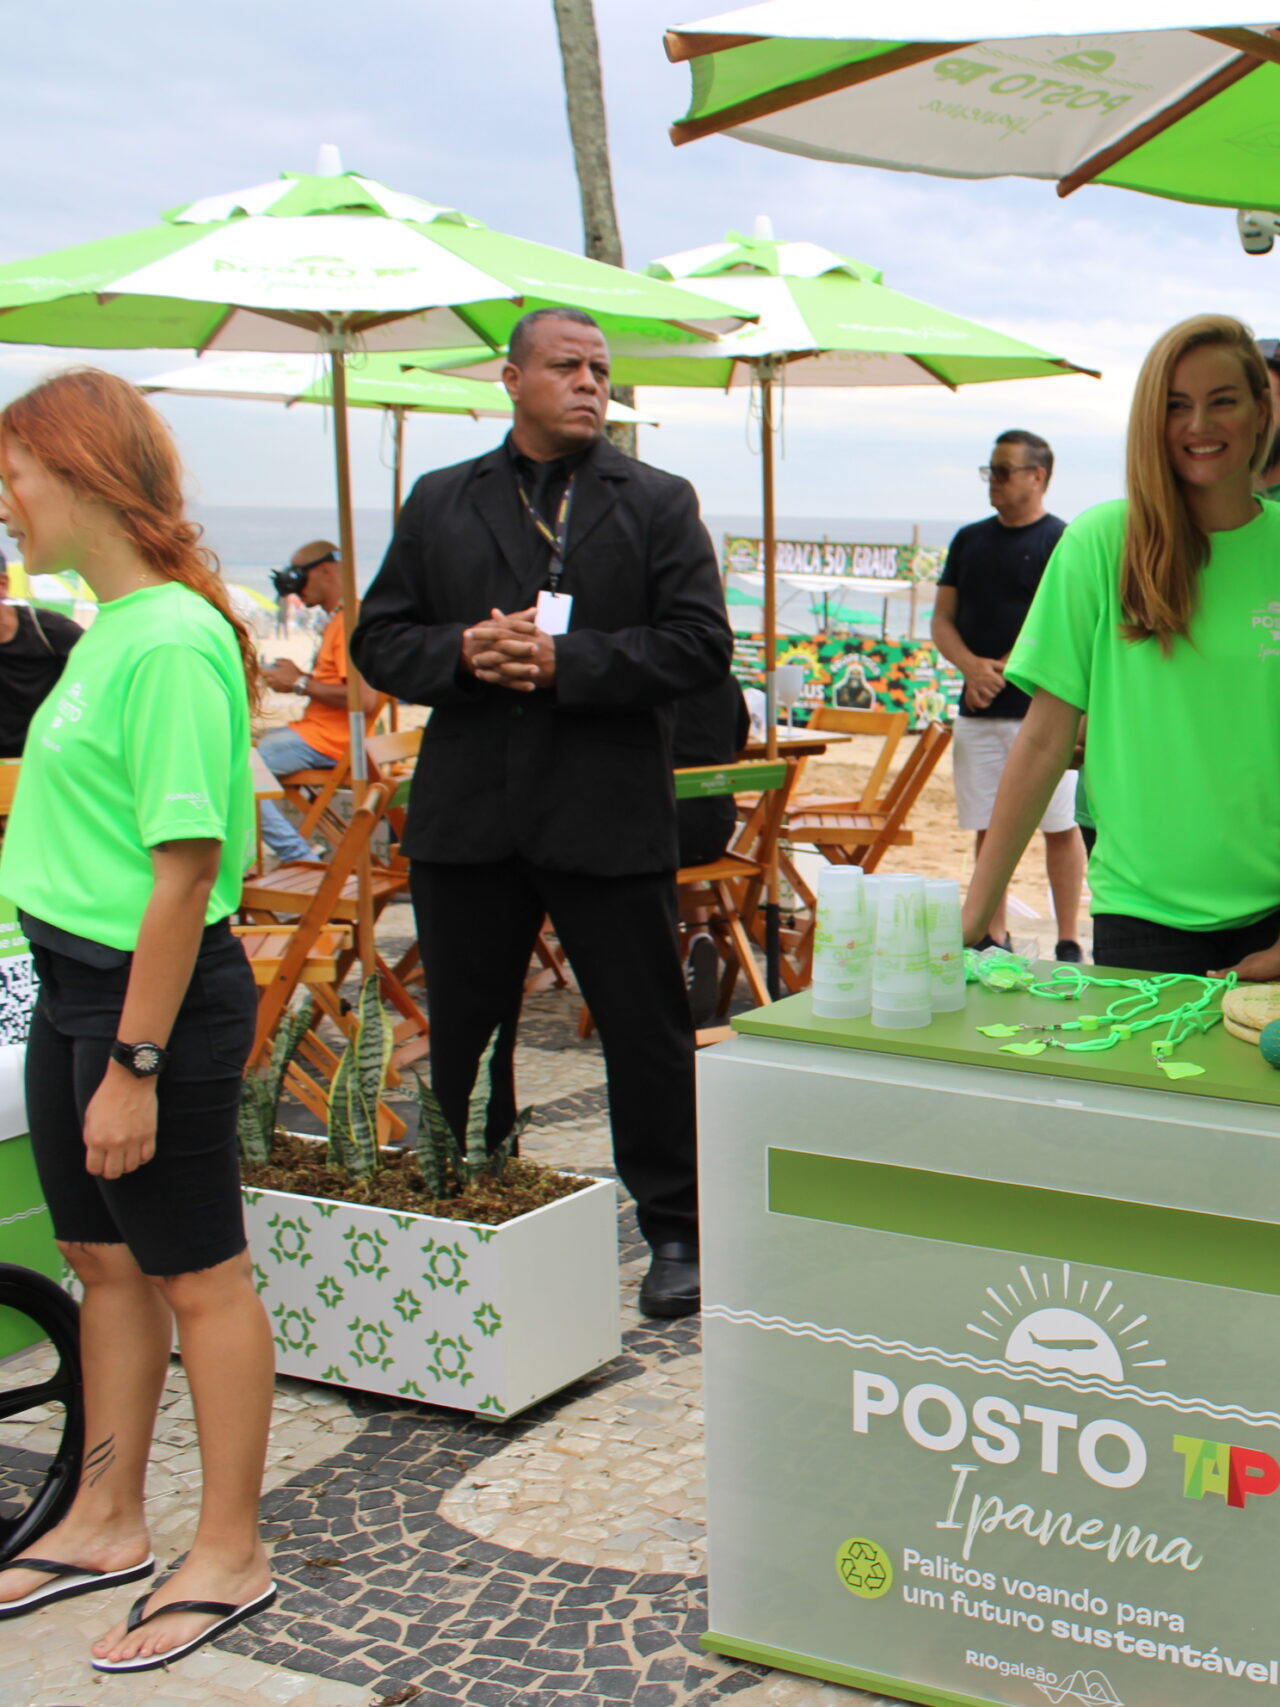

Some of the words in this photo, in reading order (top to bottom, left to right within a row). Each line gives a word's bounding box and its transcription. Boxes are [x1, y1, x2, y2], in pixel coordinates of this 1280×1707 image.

[757, 541, 821, 574] BRRACA
[853, 546, 897, 578] GRAUS
[852, 1369, 1148, 1489] POSTO
[935, 1463, 1204, 1571] Ipanema
[902, 1584, 945, 1611] um
[950, 1590, 1045, 1633] futuro
[1050, 1616, 1279, 1685] sustentável
[903, 1547, 996, 1592] Palitos
[1002, 1576, 1109, 1617] voando
[1116, 1602, 1186, 1634] para
[965, 1648, 1058, 1685] RIOgaleão
